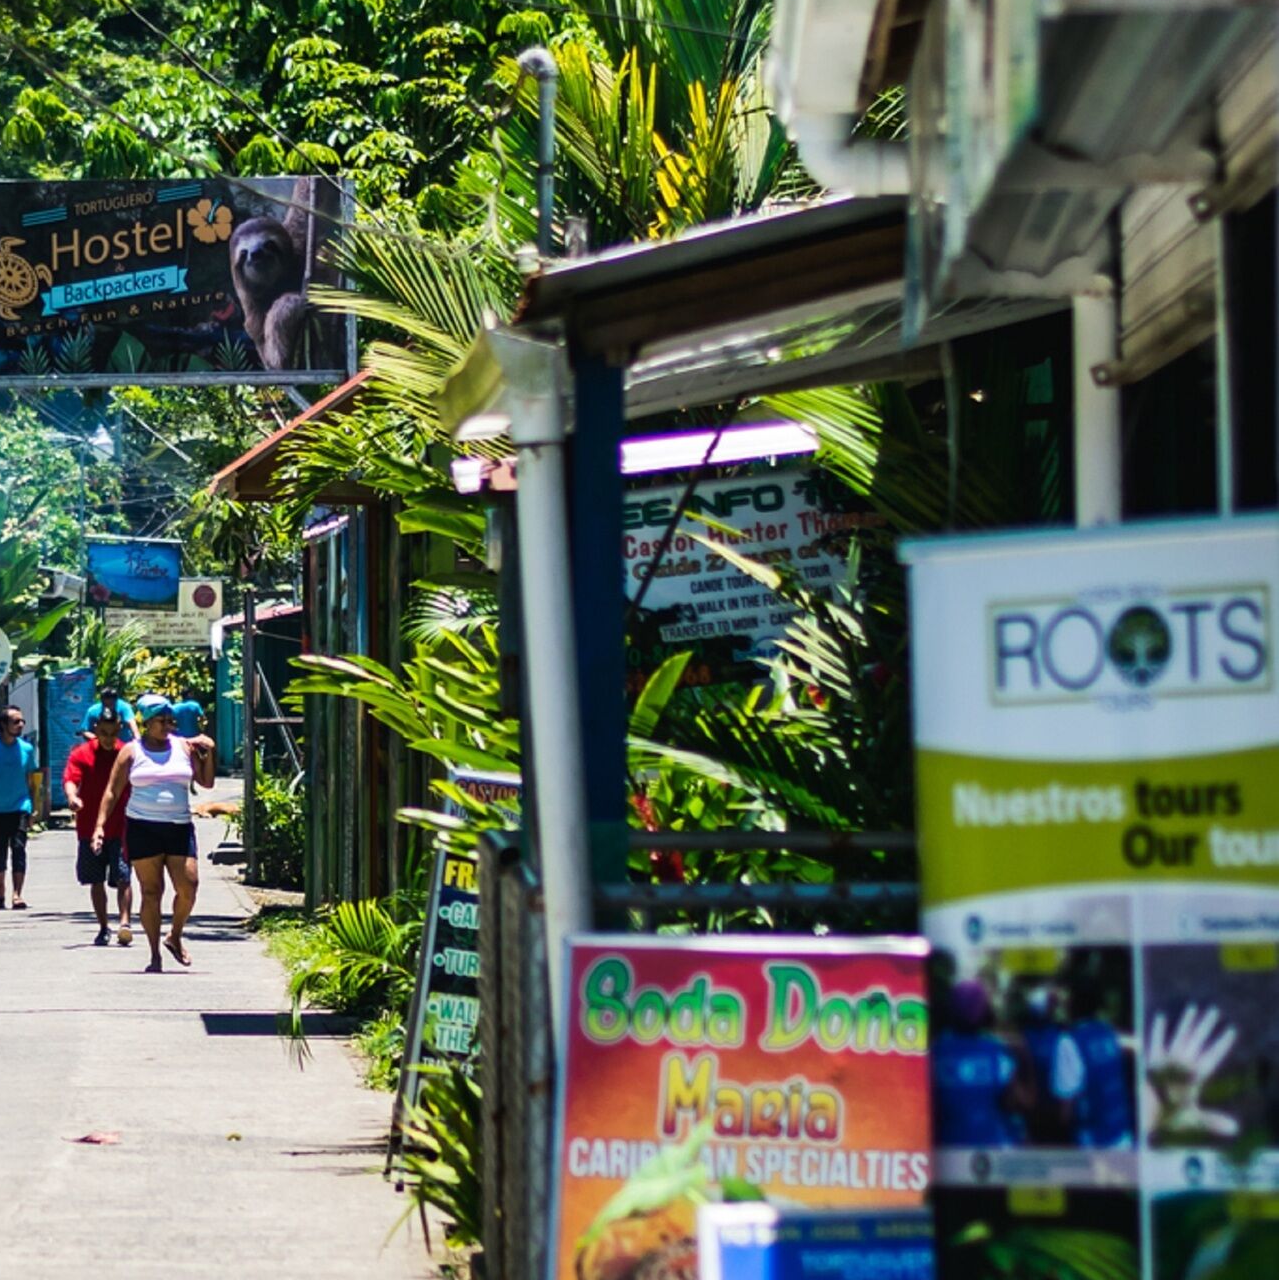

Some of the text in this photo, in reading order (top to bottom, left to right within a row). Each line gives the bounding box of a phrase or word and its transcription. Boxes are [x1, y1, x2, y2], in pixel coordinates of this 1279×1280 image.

[74, 191, 153, 216] TORTUGUERO
[52, 208, 183, 270] Hostel
[63, 271, 167, 305] Backpackers
[81, 309, 116, 323] Fun
[129, 304, 141, 316] &
[152, 291, 225, 311] Nature
[695, 599, 725, 615] WALK
[728, 598, 738, 611] IN
[740, 594, 760, 610] THE
[662, 621, 714, 641] TRANSFER
[952, 778, 1242, 827] Nuestros tours
[1122, 824, 1199, 869] Our
[582, 956, 744, 1046] Soda
[745, 1147, 930, 1191] SPECIALTIES
